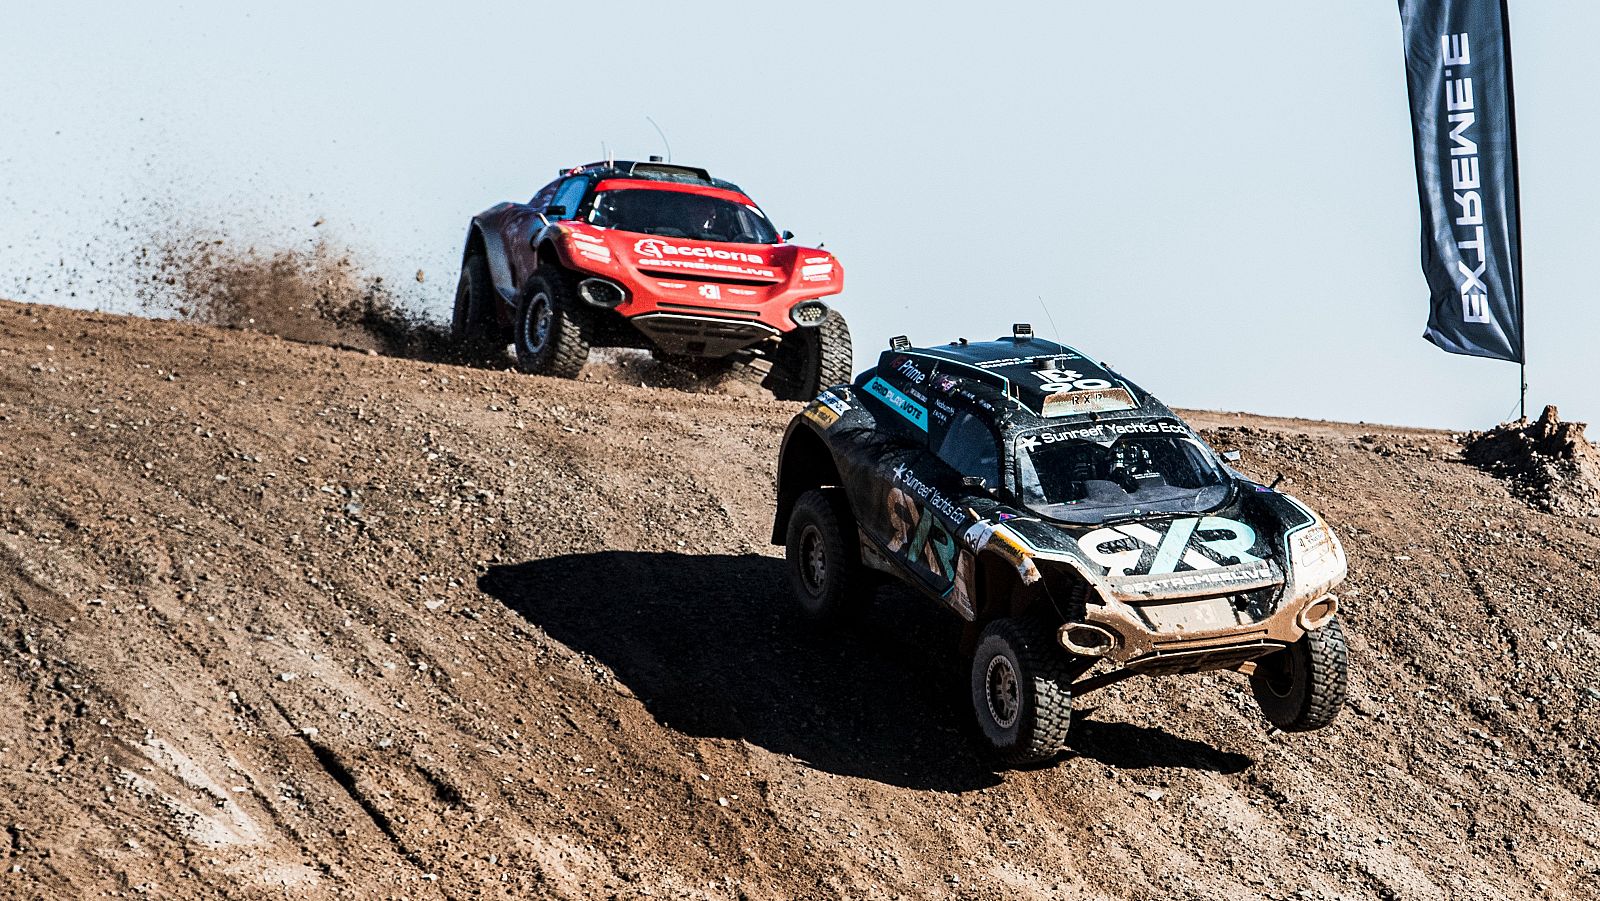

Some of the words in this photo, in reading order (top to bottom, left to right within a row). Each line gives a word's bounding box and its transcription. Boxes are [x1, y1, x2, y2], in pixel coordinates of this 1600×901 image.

[662, 246, 763, 265] acciona
[897, 359, 926, 384] Prime
[1041, 424, 1104, 444] Sunreef
[1105, 422, 1159, 435] Yachts
[1159, 422, 1188, 434] Eco
[902, 469, 936, 500] Sunreef
[929, 489, 955, 516] Yachts
[950, 506, 966, 525] Eco
